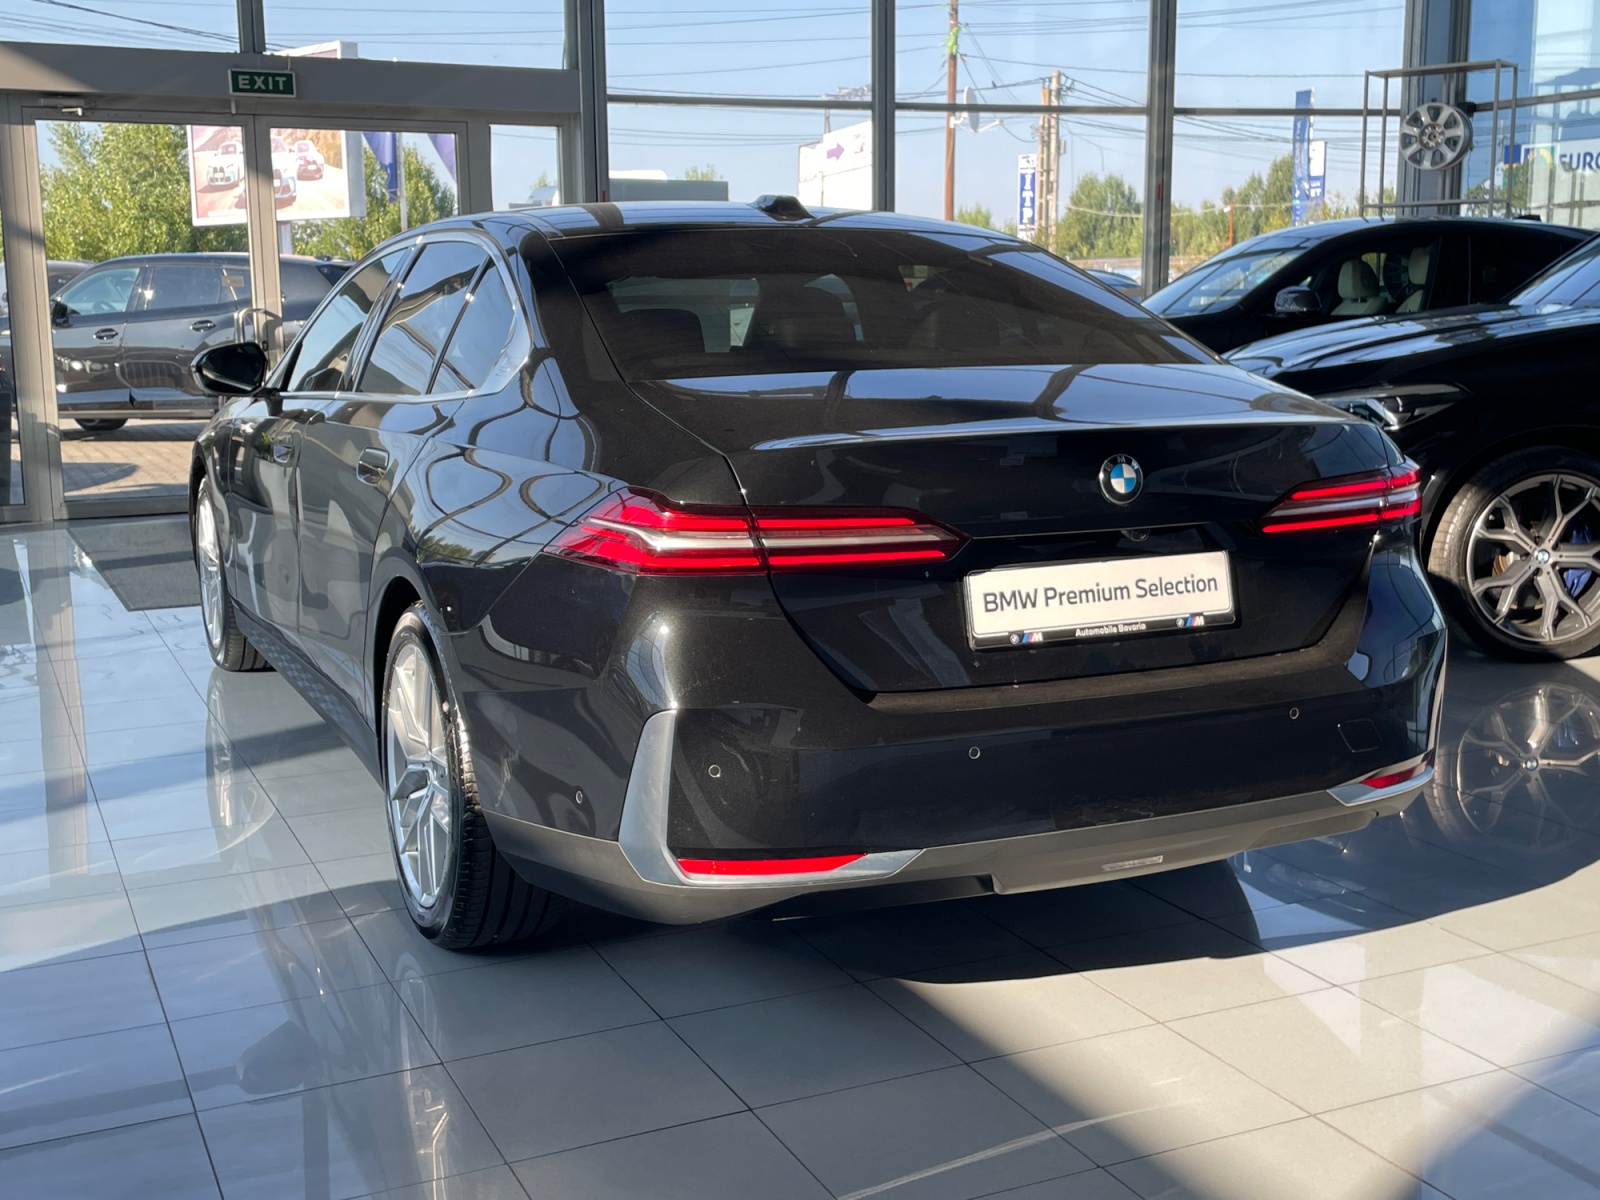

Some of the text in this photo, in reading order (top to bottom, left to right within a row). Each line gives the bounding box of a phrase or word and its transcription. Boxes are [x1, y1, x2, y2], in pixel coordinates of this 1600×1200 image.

[238, 75, 287, 90] EXIT
[1559, 151, 1600, 171] EUR
[1022, 174, 1033, 224] ITP
[983, 573, 1218, 613] BMW Premium Selection
[1075, 622, 1147, 637] Automobile Bavaria
